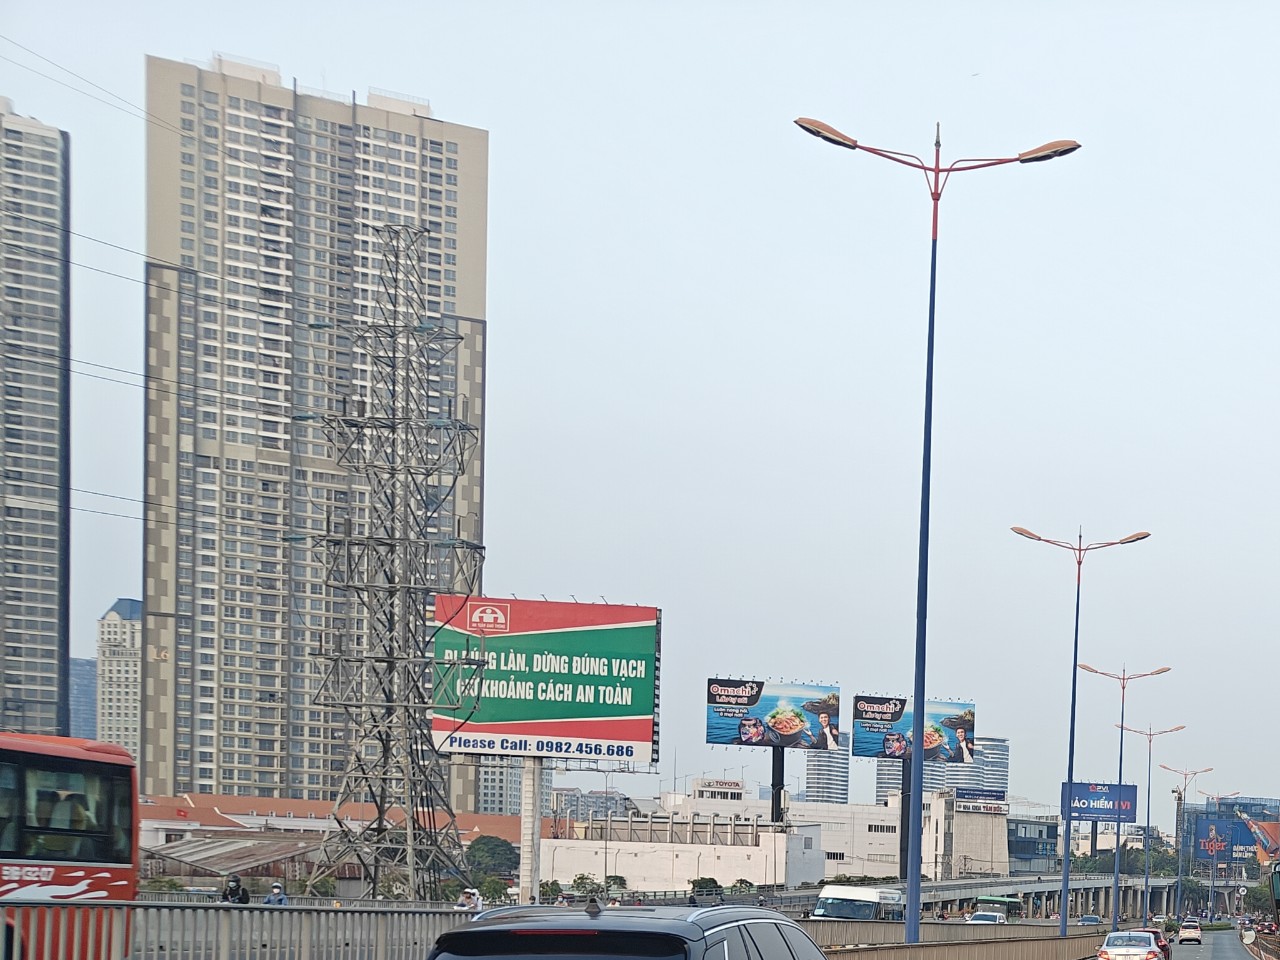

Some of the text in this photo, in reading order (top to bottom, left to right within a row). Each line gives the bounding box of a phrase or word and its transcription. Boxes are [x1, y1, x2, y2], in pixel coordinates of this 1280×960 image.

[533, 650, 569, 674] DỪNG
[572, 653, 608, 676] ĐÚNG
[612, 658, 646, 682] VẠCH
[481, 674, 534, 700] KHOẢNG
[537, 679, 573, 702] CÁCH
[576, 685, 595, 703] AN
[598, 683, 633, 706] TOÀN
[449, 735, 635, 758] Please Call: 0982.456.686
[715, 780, 740, 788] TOYOTA
[1090, 796, 1113, 809] HIỂM
[1200, 839, 1227, 856] Tiger
